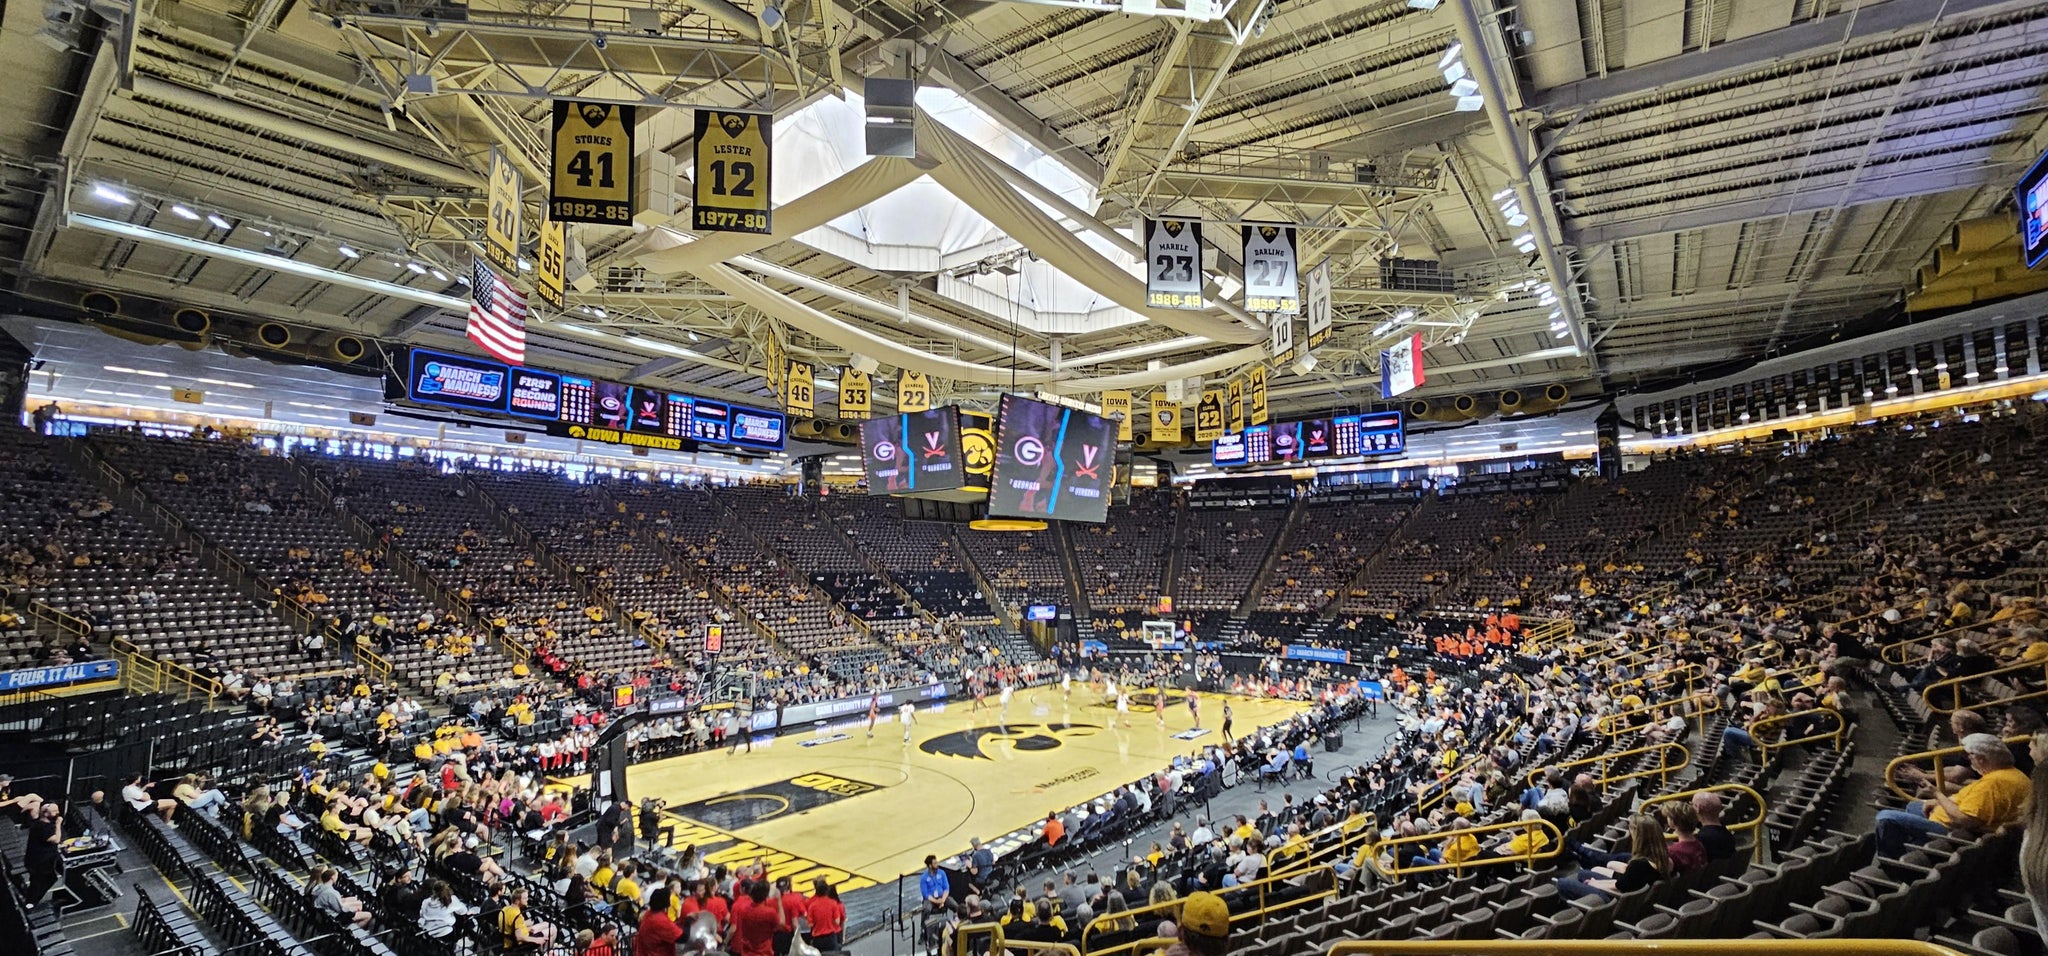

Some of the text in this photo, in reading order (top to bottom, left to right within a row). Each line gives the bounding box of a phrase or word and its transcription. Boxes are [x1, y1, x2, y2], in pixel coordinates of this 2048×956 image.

[574, 135, 612, 146] STOKES
[714, 145, 752, 156] LESTER
[567, 150, 614, 188] 41
[710, 160, 754, 197] 12
[554, 202, 629, 220] 1982-85
[492, 200, 514, 242] 40
[698, 211, 767, 229] 1977-80
[1159, 243, 1188, 252] MARBLE
[1254, 248, 1285, 257] DARLING
[487, 240, 517, 273] 1991-93
[544, 242, 561, 281] 55
[1156, 254, 1193, 282] 23
[1253, 260, 1288, 287] 27
[1150, 293, 1202, 307] 1986-89
[1247, 298, 1297, 310] 1950-52
[1312, 296, 1326, 325] 17
[1276, 322, 1288, 347] 10
[440, 367, 482, 383] MARCH
[518, 376, 552, 390] FIRST
[443, 380, 499, 398] MADNESS
[514, 388, 556, 402] SECOND
[792, 385, 810, 402] 46
[844, 389, 867, 404] 33
[512, 396, 556, 412] ROUNDS
[903, 390, 925, 406] 22
[746, 416, 768, 428] MARCH
[1200, 410, 1220, 428] 22
[586, 428, 682, 450] IOWA HAWKEYES
[748, 426, 780, 439] MADNESS
[9, 666, 86, 688] FOUR IT ALL
